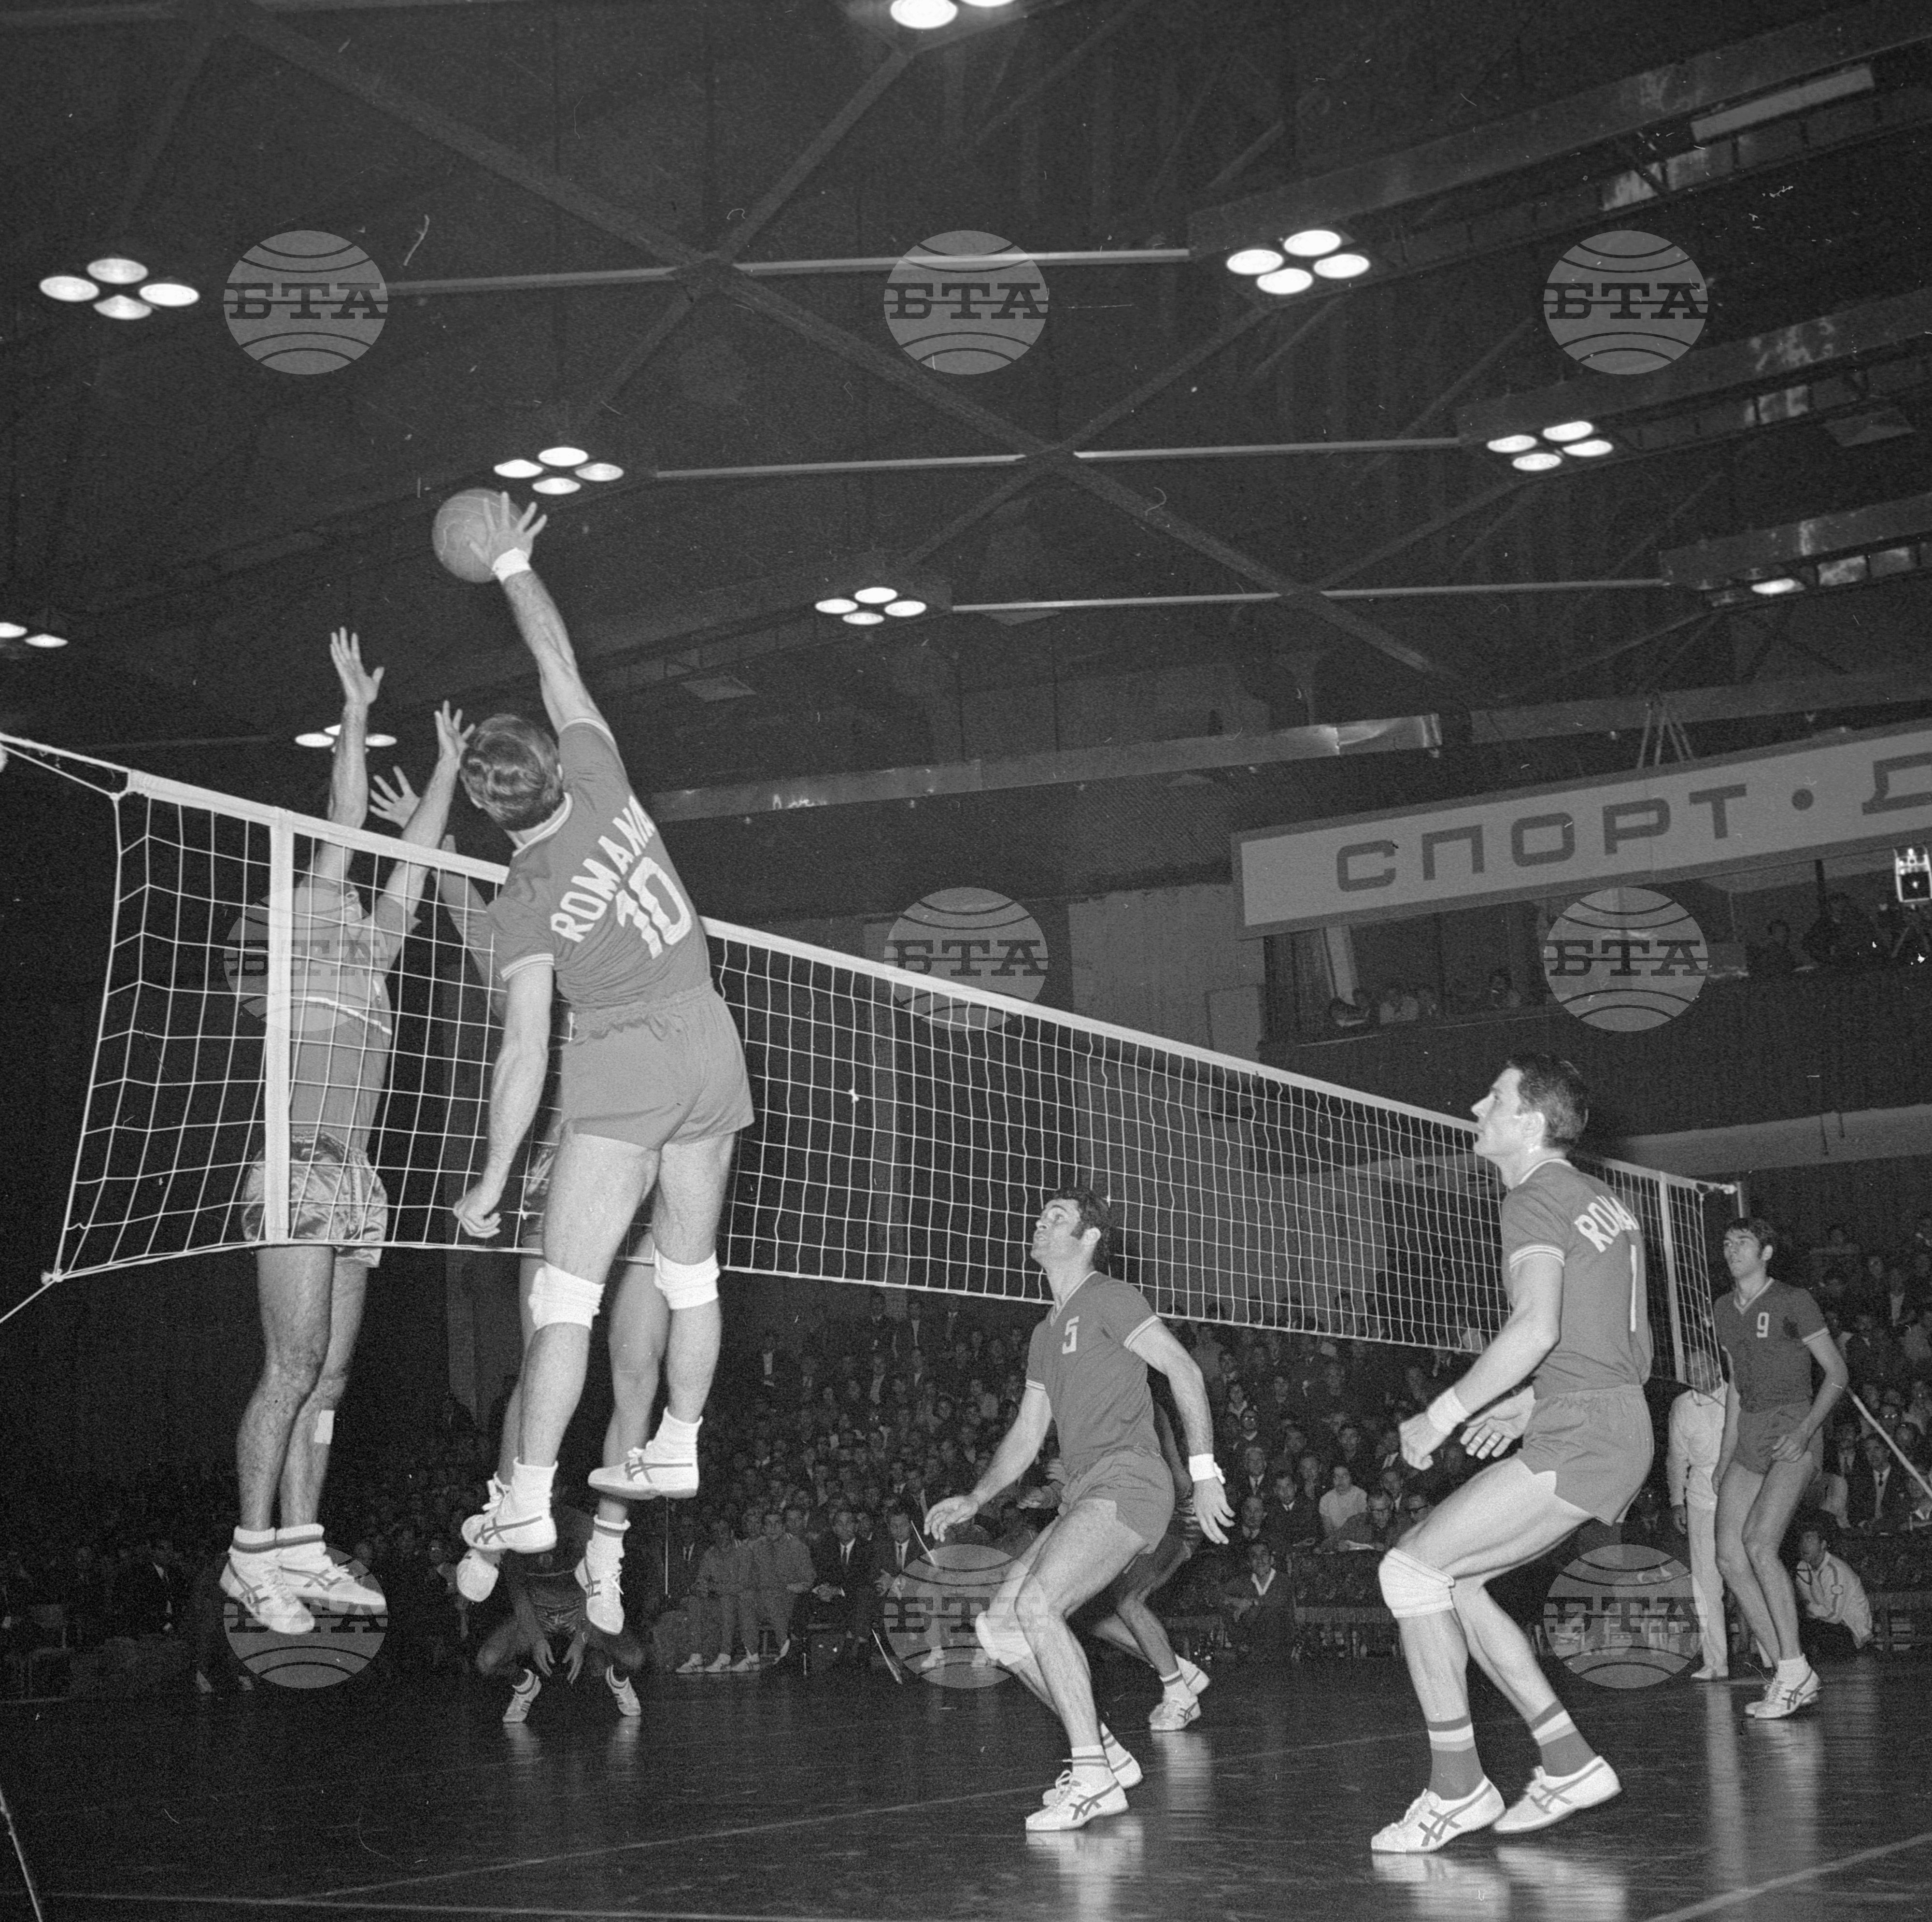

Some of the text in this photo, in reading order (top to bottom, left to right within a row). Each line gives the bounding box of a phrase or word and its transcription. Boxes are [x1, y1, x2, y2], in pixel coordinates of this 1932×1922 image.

[1336, 783, 1747, 893] СПОРТ
[615, 856, 692, 959] 10
[1574, 1196, 1640, 1253] ROMA
[1630, 1244, 1637, 1332] 1
[1062, 1316, 1080, 1354] 5
[1756, 1312, 1769, 1338] 9
